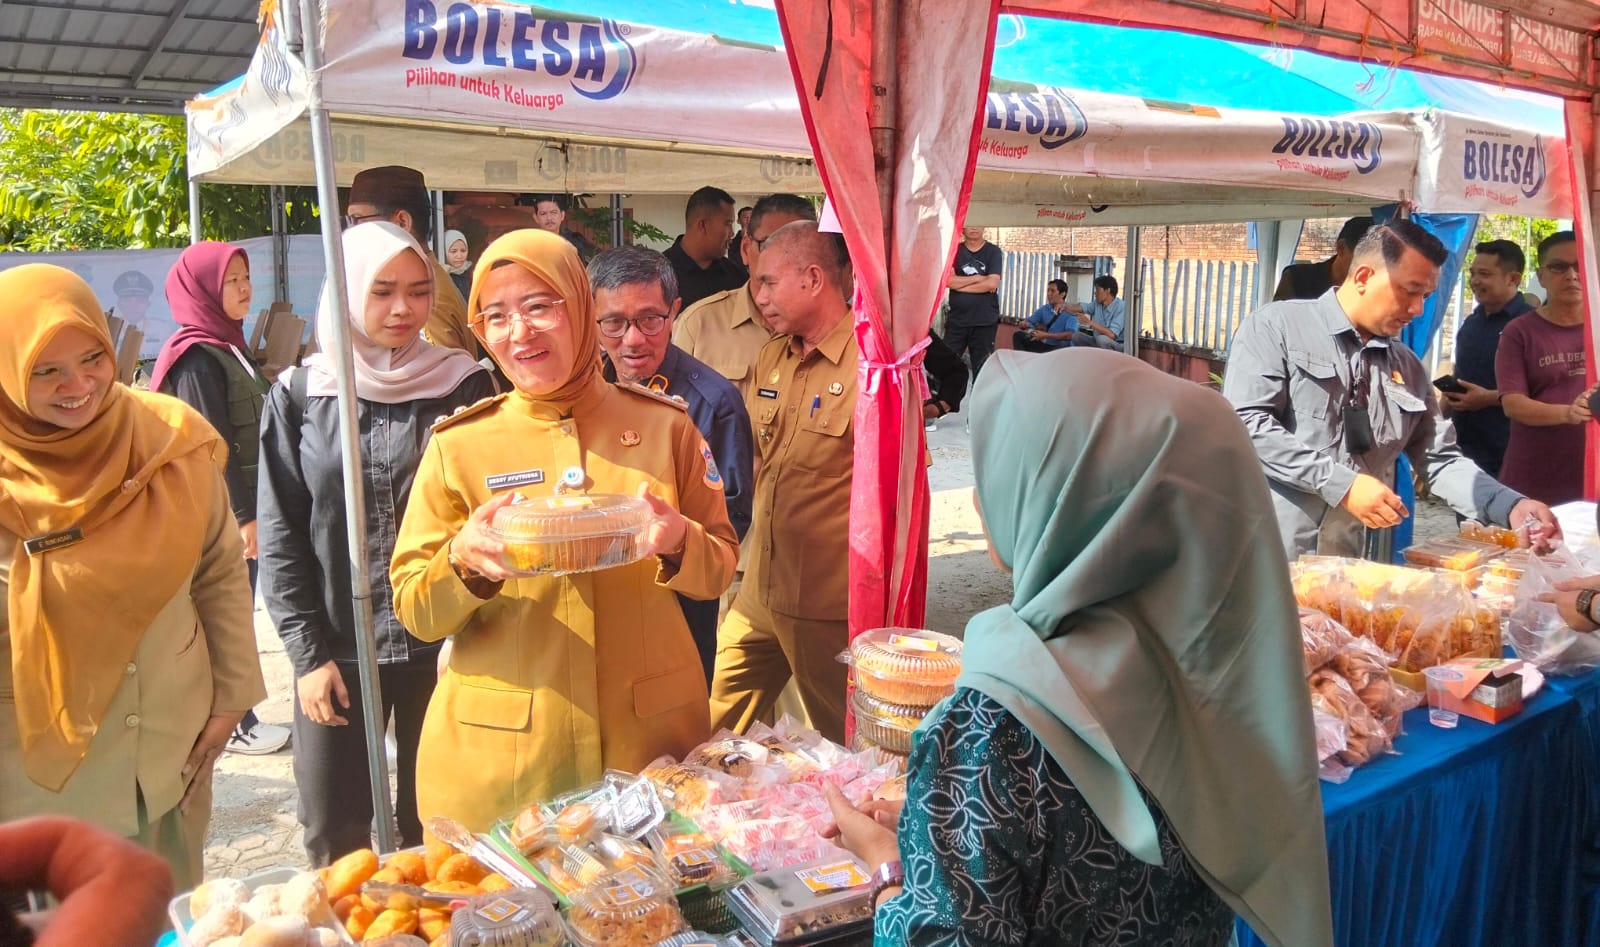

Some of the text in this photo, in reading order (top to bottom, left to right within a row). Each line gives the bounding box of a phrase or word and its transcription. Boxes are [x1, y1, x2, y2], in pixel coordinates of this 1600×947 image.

[402, 0, 605, 82] BOLESA
[406, 66, 563, 111] Pilihan untuk Keluarga
[986, 91, 1067, 137] LESA
[989, 142, 1028, 159] Keluarga
[1271, 117, 1368, 160] BOLESA
[1464, 139, 1535, 186] BOLESA
